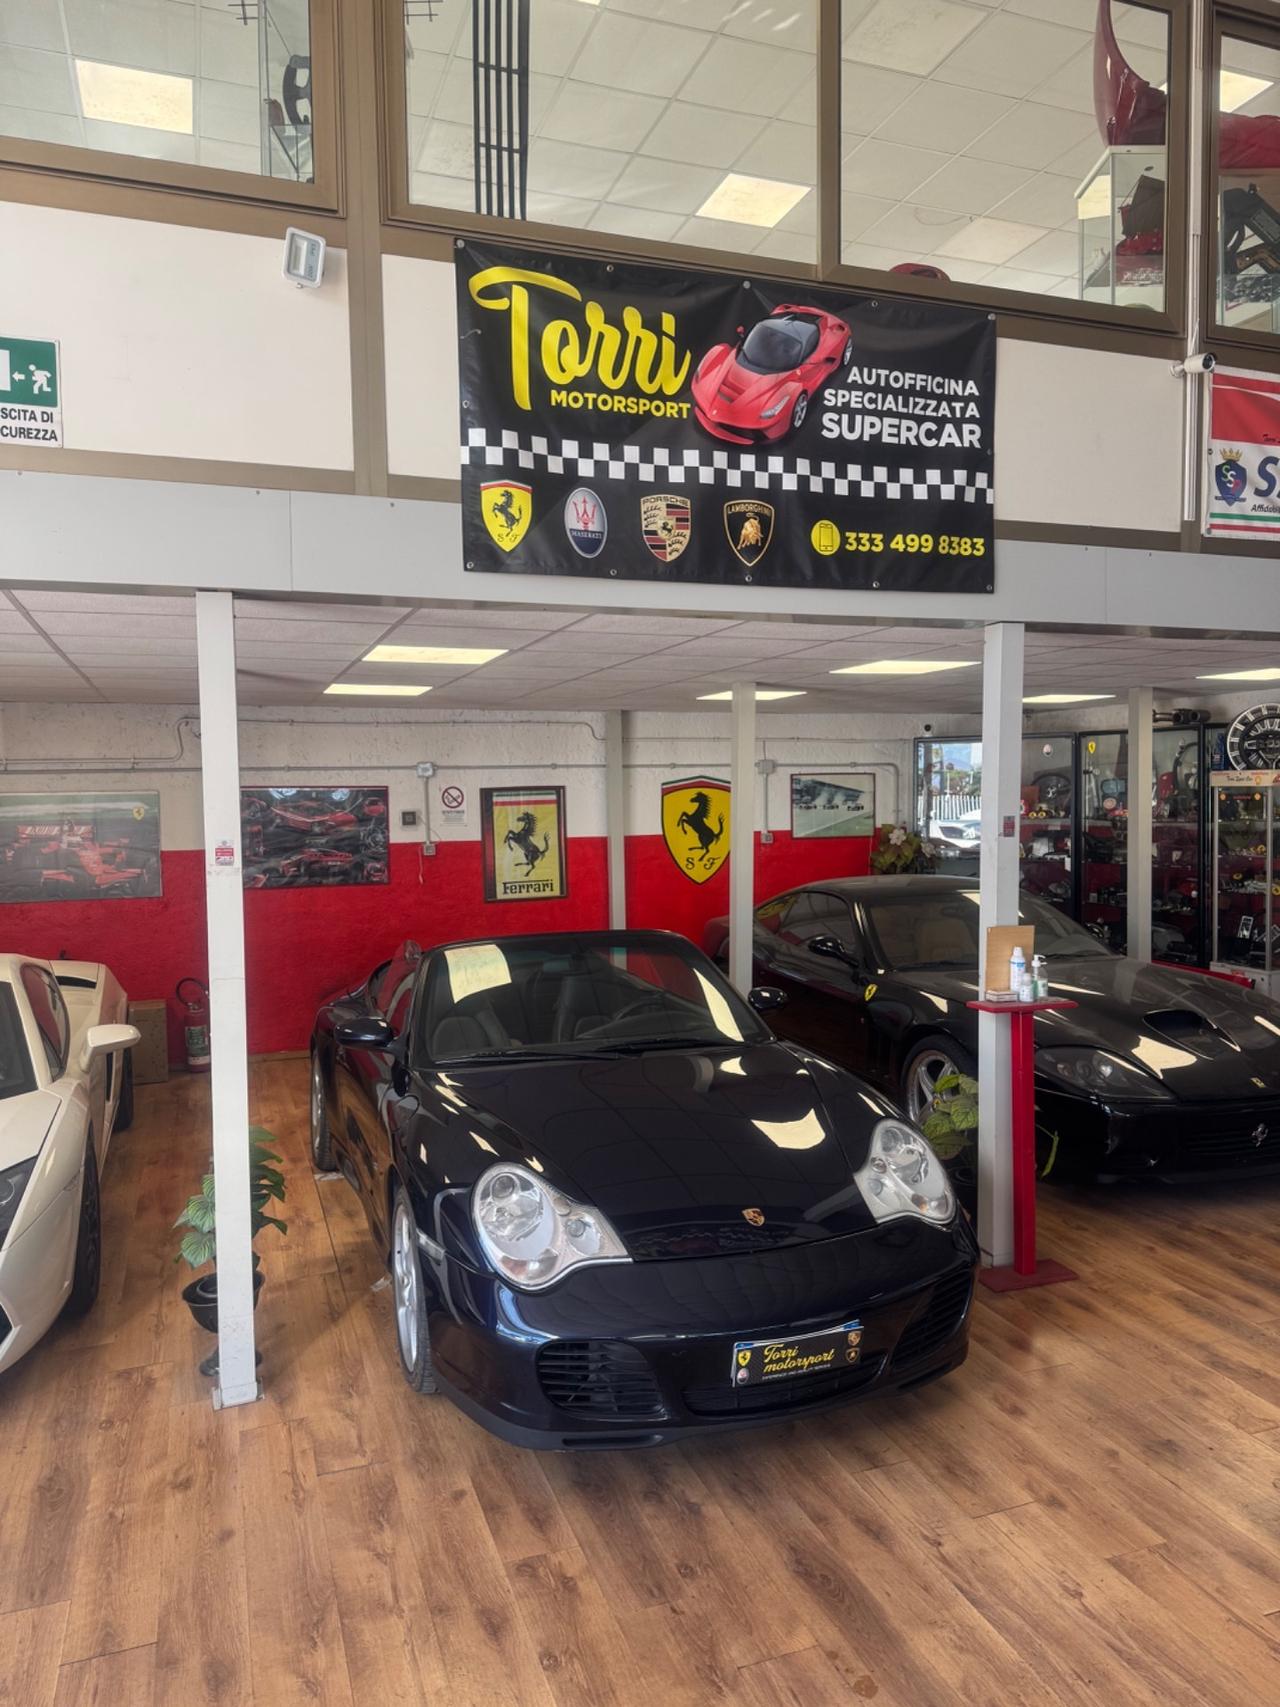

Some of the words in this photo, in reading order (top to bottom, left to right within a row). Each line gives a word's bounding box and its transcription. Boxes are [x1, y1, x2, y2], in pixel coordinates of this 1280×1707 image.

[468, 266, 692, 411] Torri
[847, 366, 980, 396] AUTOFFICINA
[551, 390, 691, 419] MOTORSPORT
[823, 388, 981, 418] SPECIALIZZATA
[40, 410, 54, 424] DI
[821, 412, 982, 449] SUPERCAR
[642, 495, 690, 506] PORSCHE
[845, 531, 884, 553] 333
[889, 533, 934, 553] 499
[938, 535, 985, 557] 8383
[502, 879, 555, 895] Ferrari
[763, 1343, 799, 1363] Torri
[763, 1348, 836, 1373] motorsport
